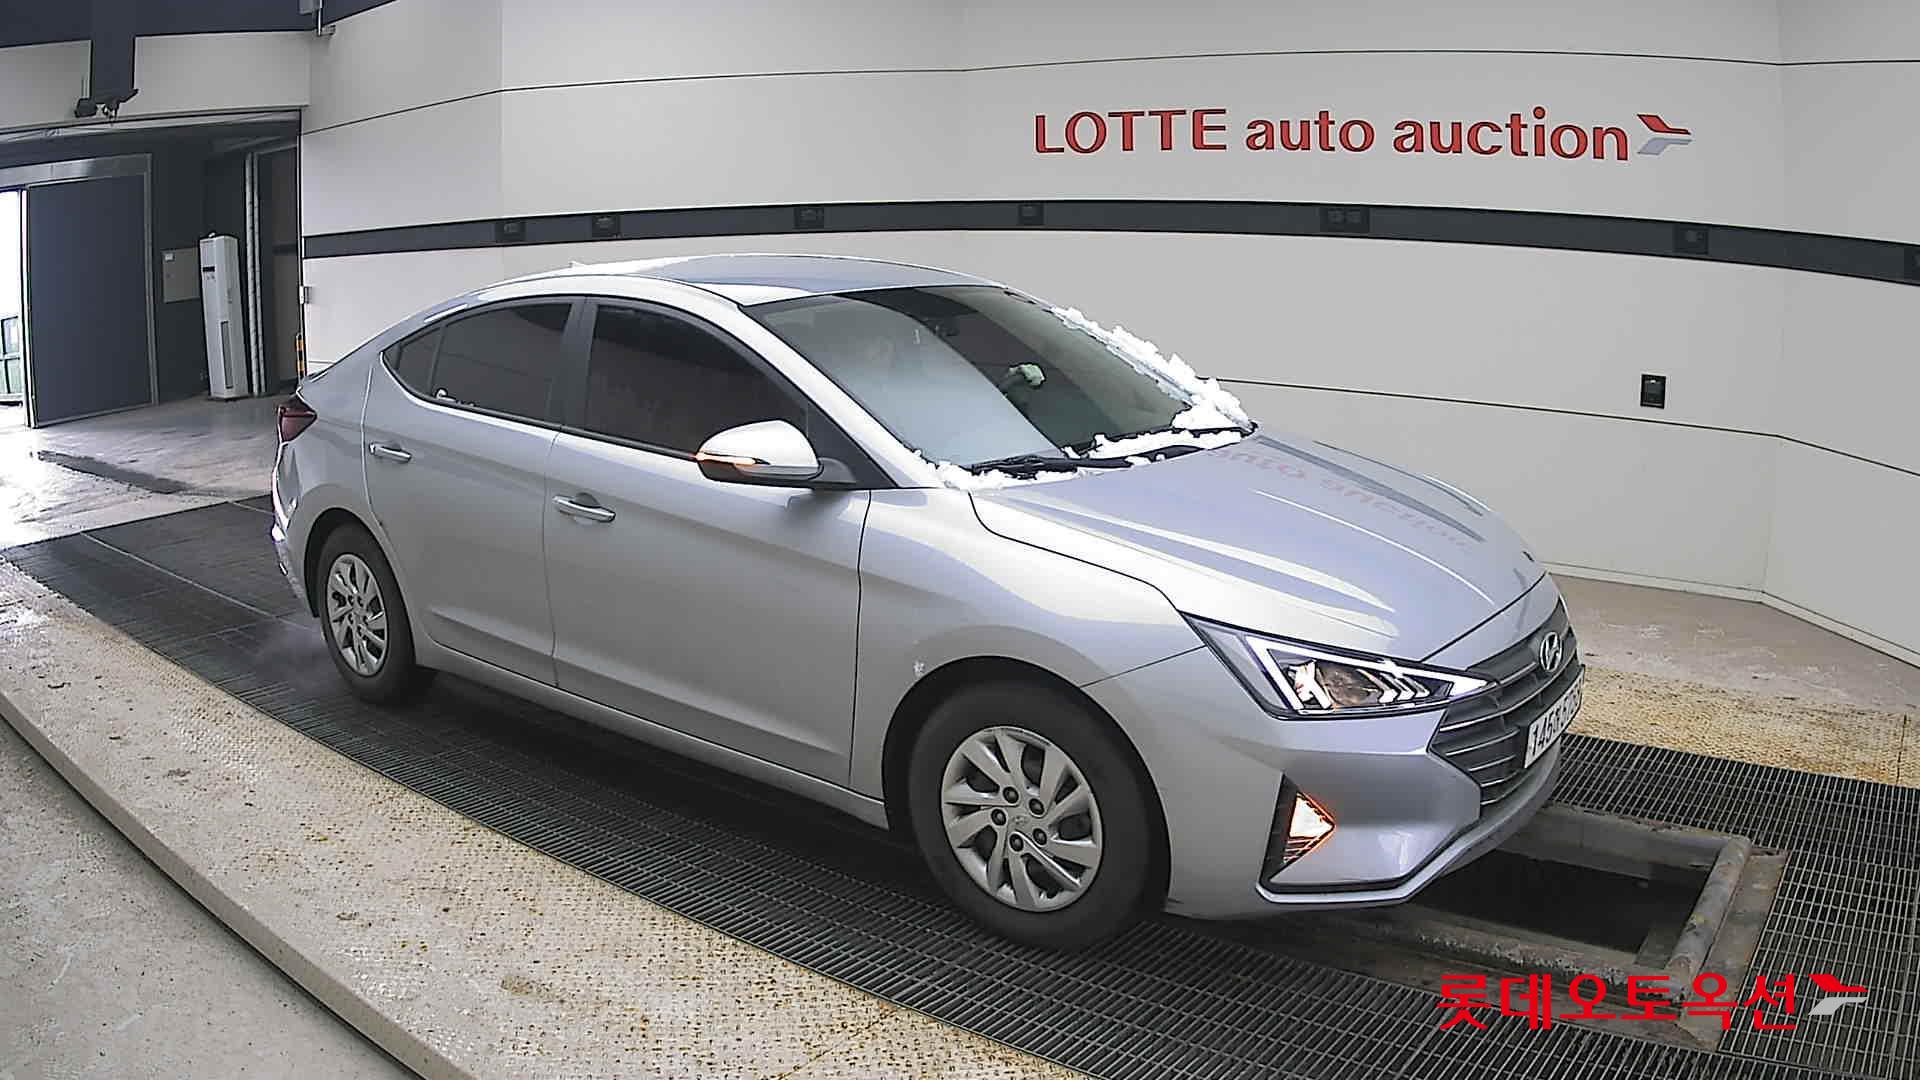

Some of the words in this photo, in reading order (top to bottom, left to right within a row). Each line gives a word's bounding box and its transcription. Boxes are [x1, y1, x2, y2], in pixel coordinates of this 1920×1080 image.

[1034, 108, 1227, 155] LOTTE
[1245, 110, 1376, 153] auto
[1392, 106, 1631, 161] auction
